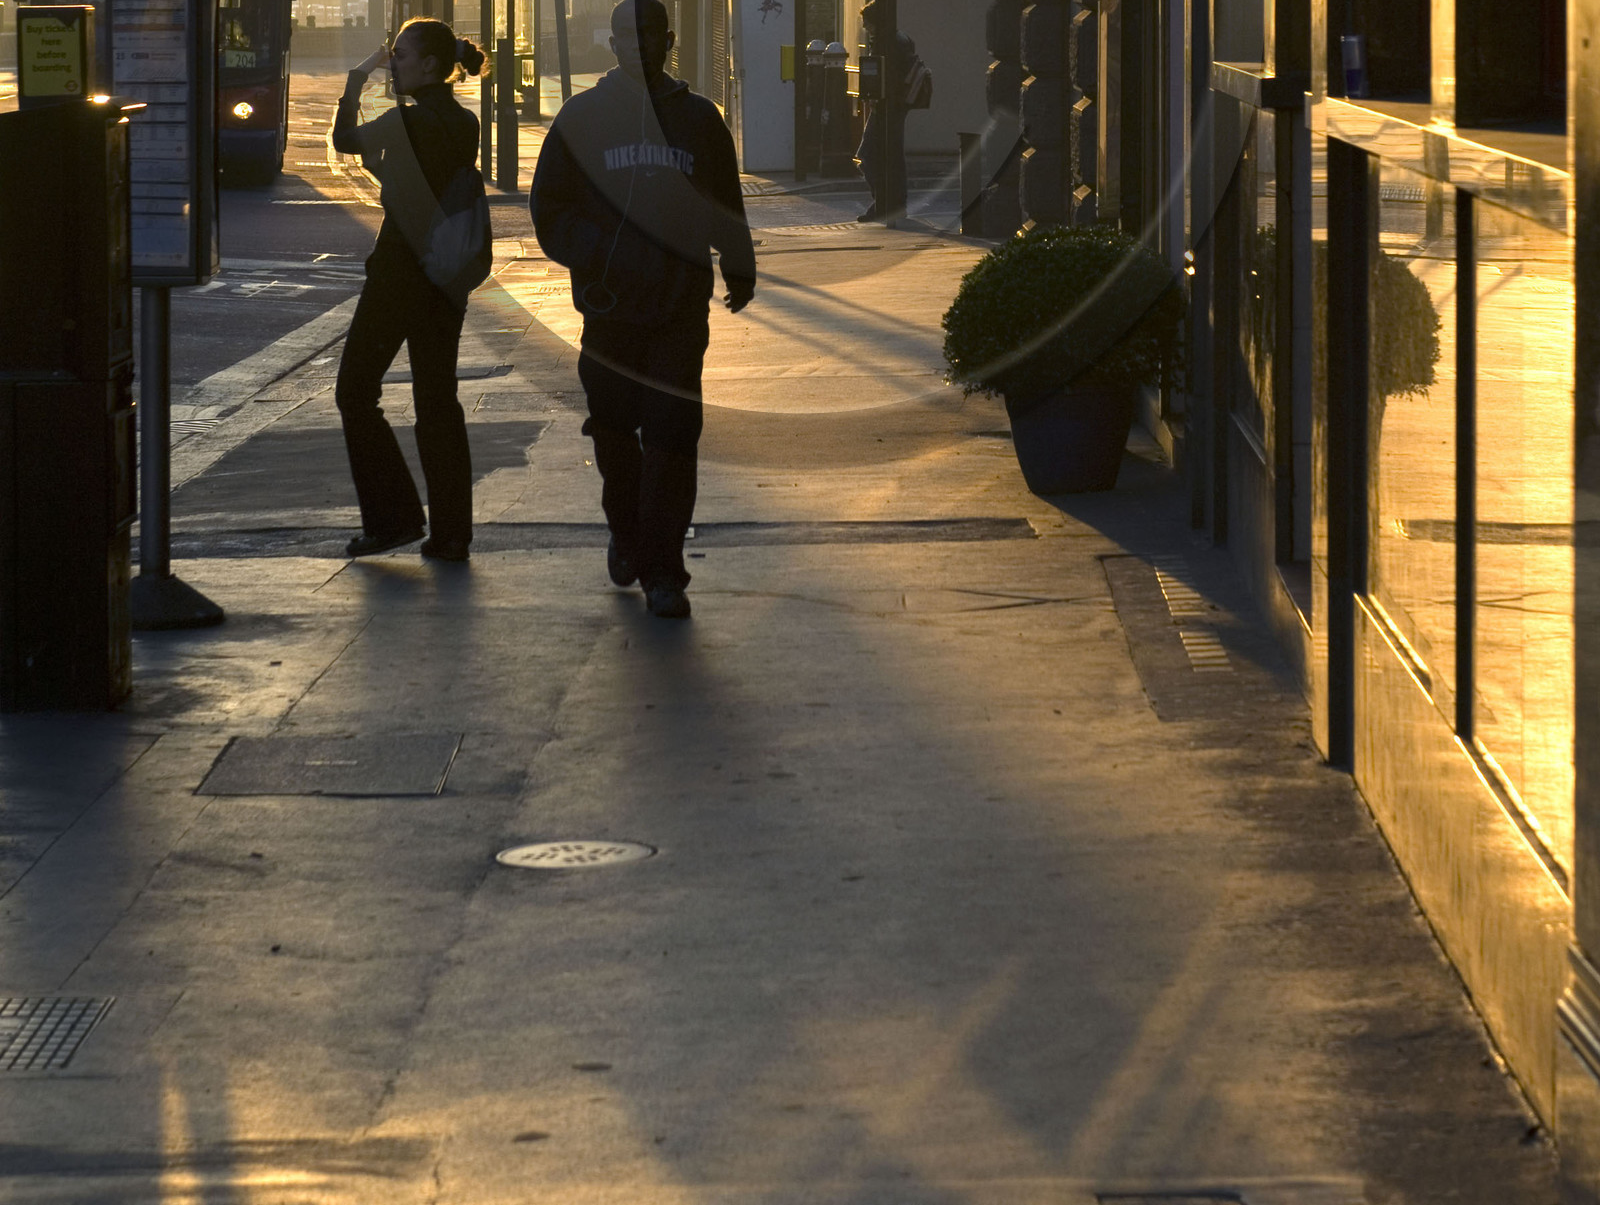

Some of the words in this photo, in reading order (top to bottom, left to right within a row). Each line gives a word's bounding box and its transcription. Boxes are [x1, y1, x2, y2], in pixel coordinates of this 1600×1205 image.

[26, 25, 43, 35] Buy
[41, 38, 62, 46] here
[36, 50, 66, 59] before
[32, 64, 72, 73] boarding
[603, 144, 636, 171] NIKE
[638, 144, 695, 176] ATHLETIC
